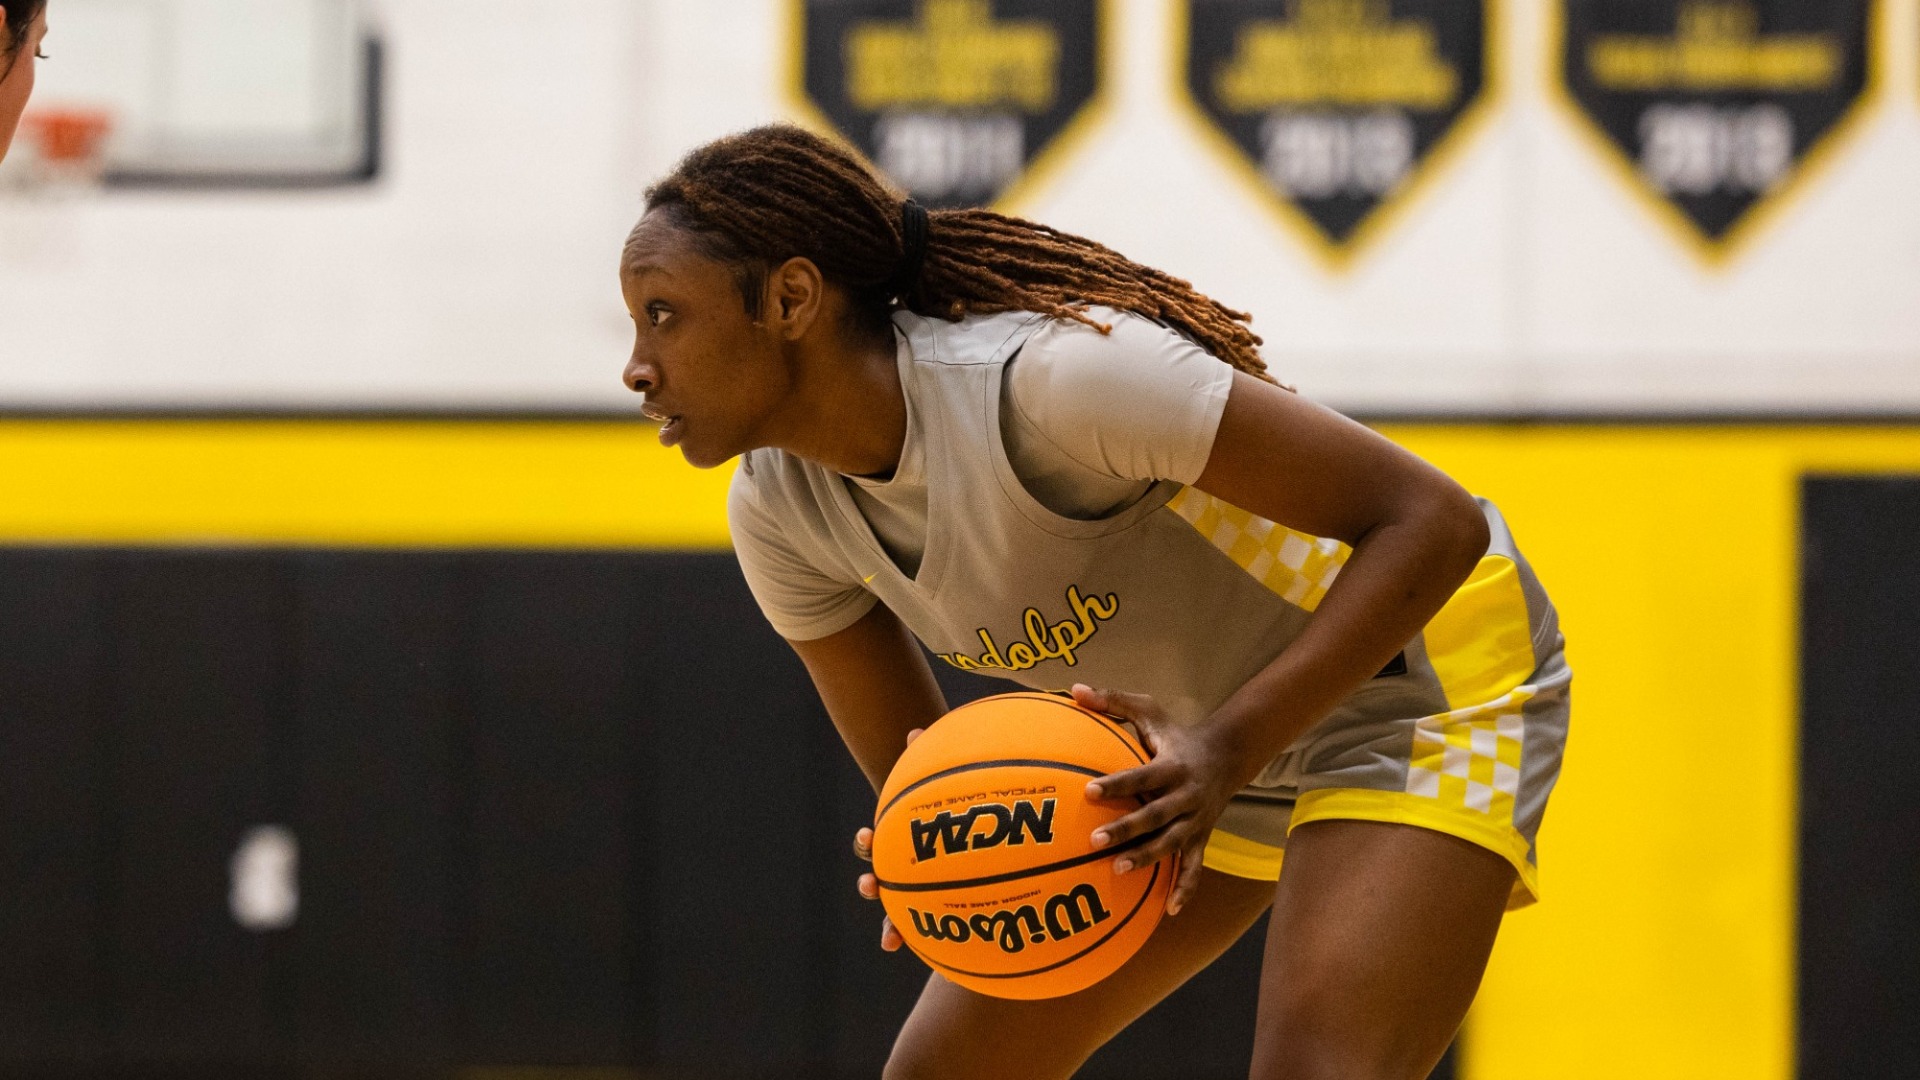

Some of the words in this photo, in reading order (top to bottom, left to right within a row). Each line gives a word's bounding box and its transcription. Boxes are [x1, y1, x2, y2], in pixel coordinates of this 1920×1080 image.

[990, 786, 1056, 798] OFFICIAL
[946, 793, 987, 805] GAME
[910, 801, 943, 812] BALL
[910, 798, 1058, 862] NCAA
[1001, 889, 1042, 905] INDOOR
[970, 900, 999, 909] GAME
[907, 883, 1112, 954] Wilson
